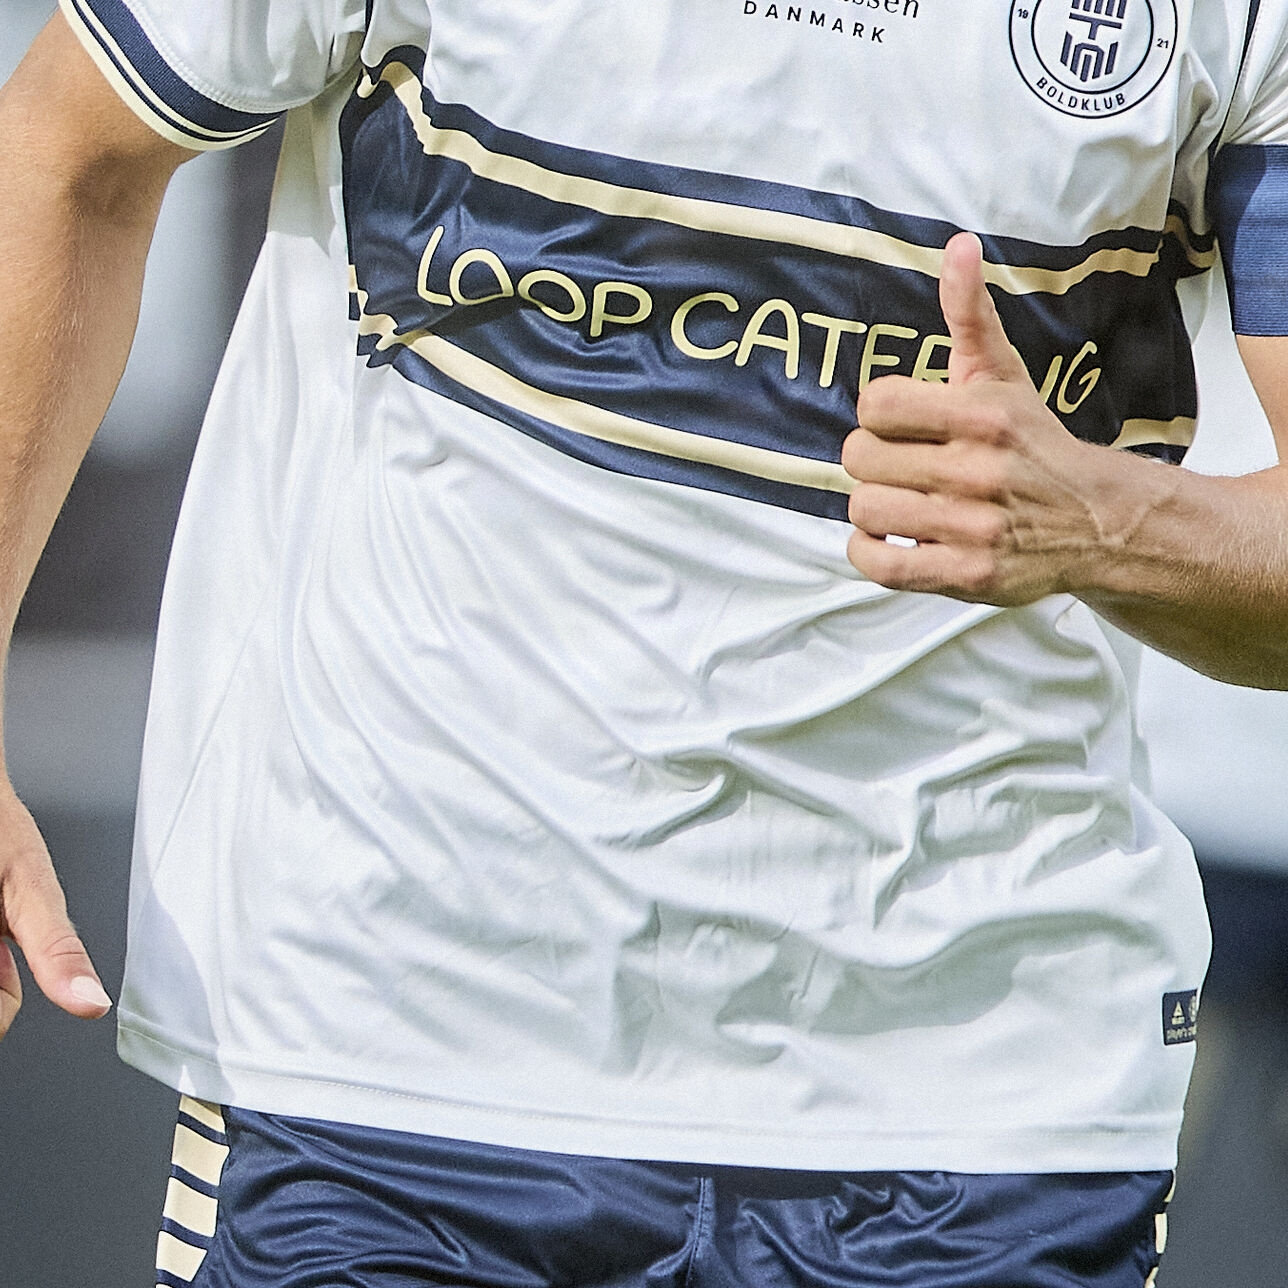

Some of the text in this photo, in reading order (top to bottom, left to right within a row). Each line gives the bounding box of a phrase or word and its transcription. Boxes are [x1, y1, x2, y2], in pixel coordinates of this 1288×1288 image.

[743, 0, 885, 43] DANMARK
[1017, 8, 1029, 19] 19
[1157, 38, 1169, 49] 21
[1036, 76, 1125, 111] BOLDKLUB
[417, 225, 652, 337] LOOP
